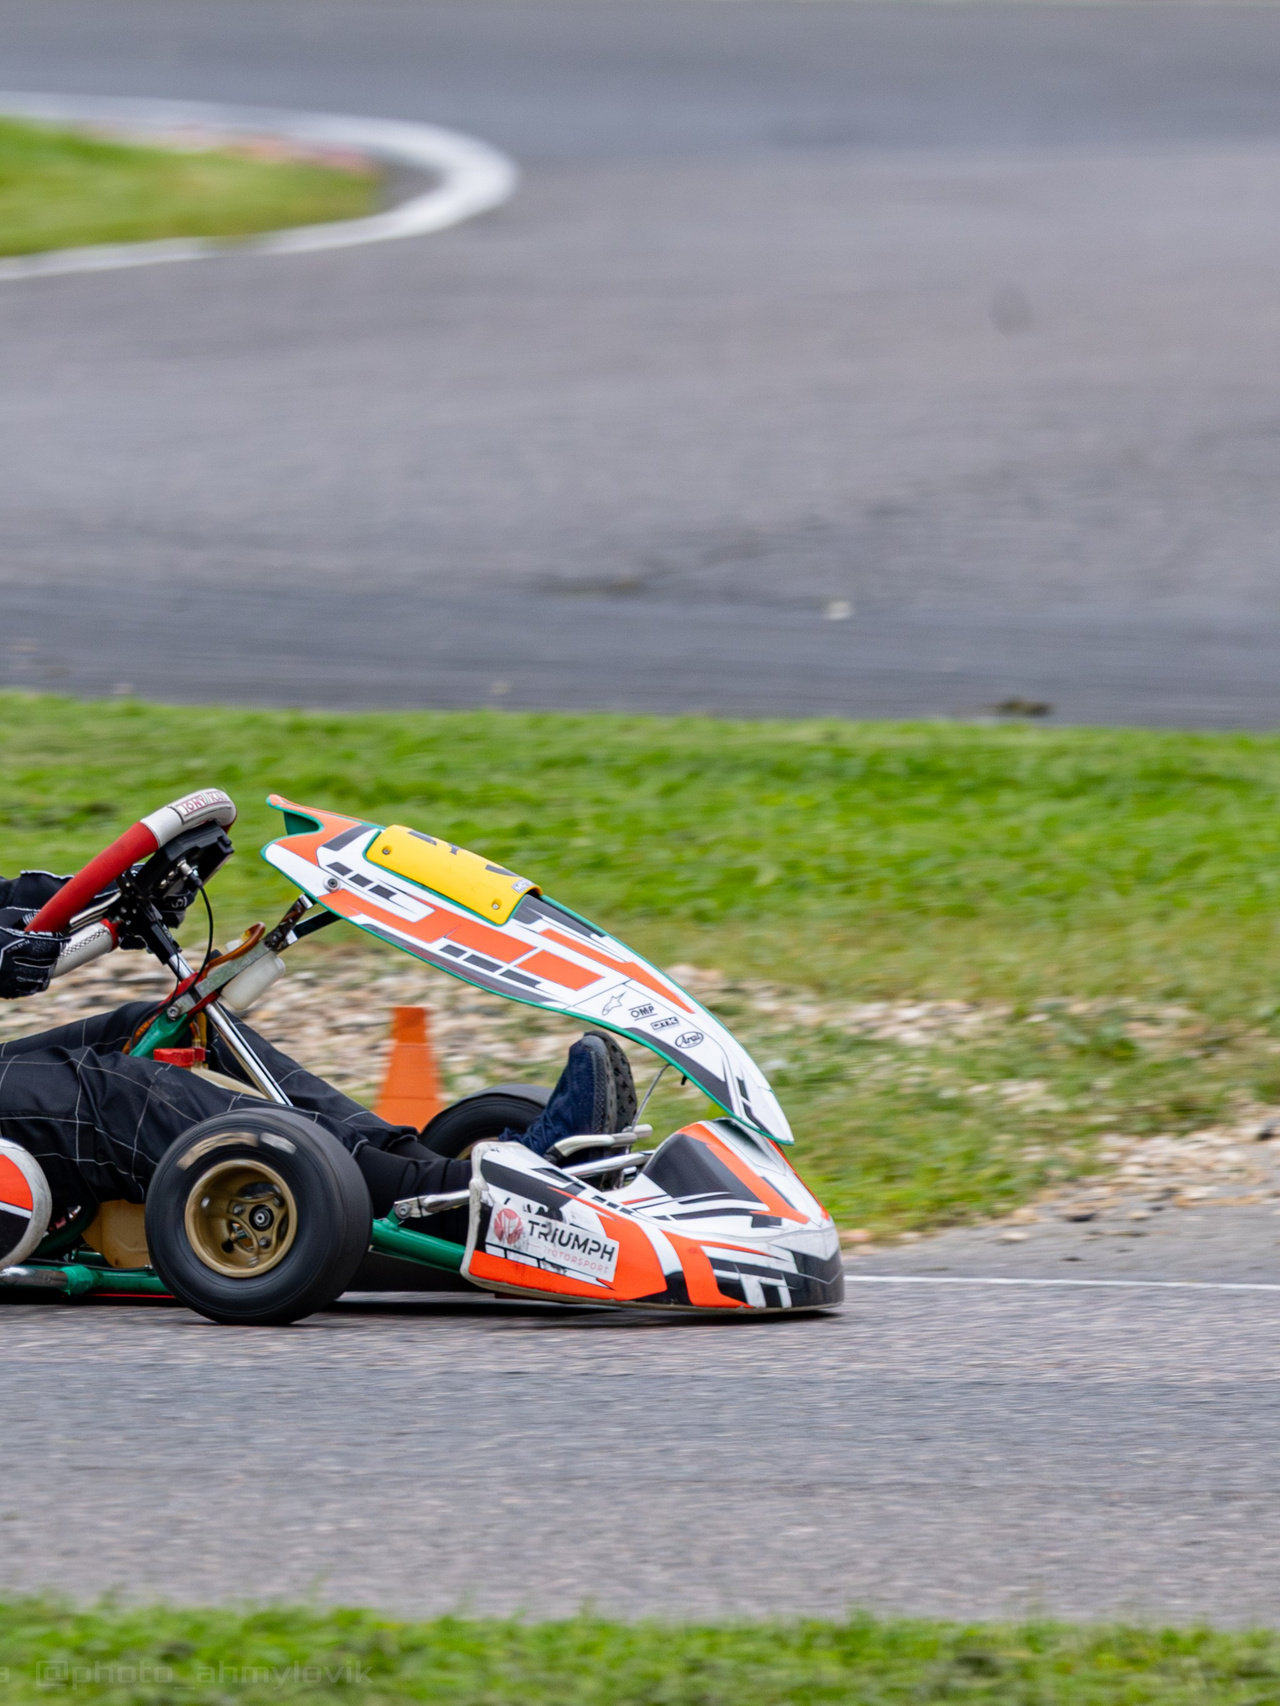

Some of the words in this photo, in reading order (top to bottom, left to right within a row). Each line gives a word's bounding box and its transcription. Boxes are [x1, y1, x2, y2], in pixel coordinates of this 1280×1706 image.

[176, 795, 206, 814] TONY
[631, 1005, 654, 1018] OMP
[676, 1032, 703, 1047] Arai
[528, 1220, 615, 1262] TRIUMPH
